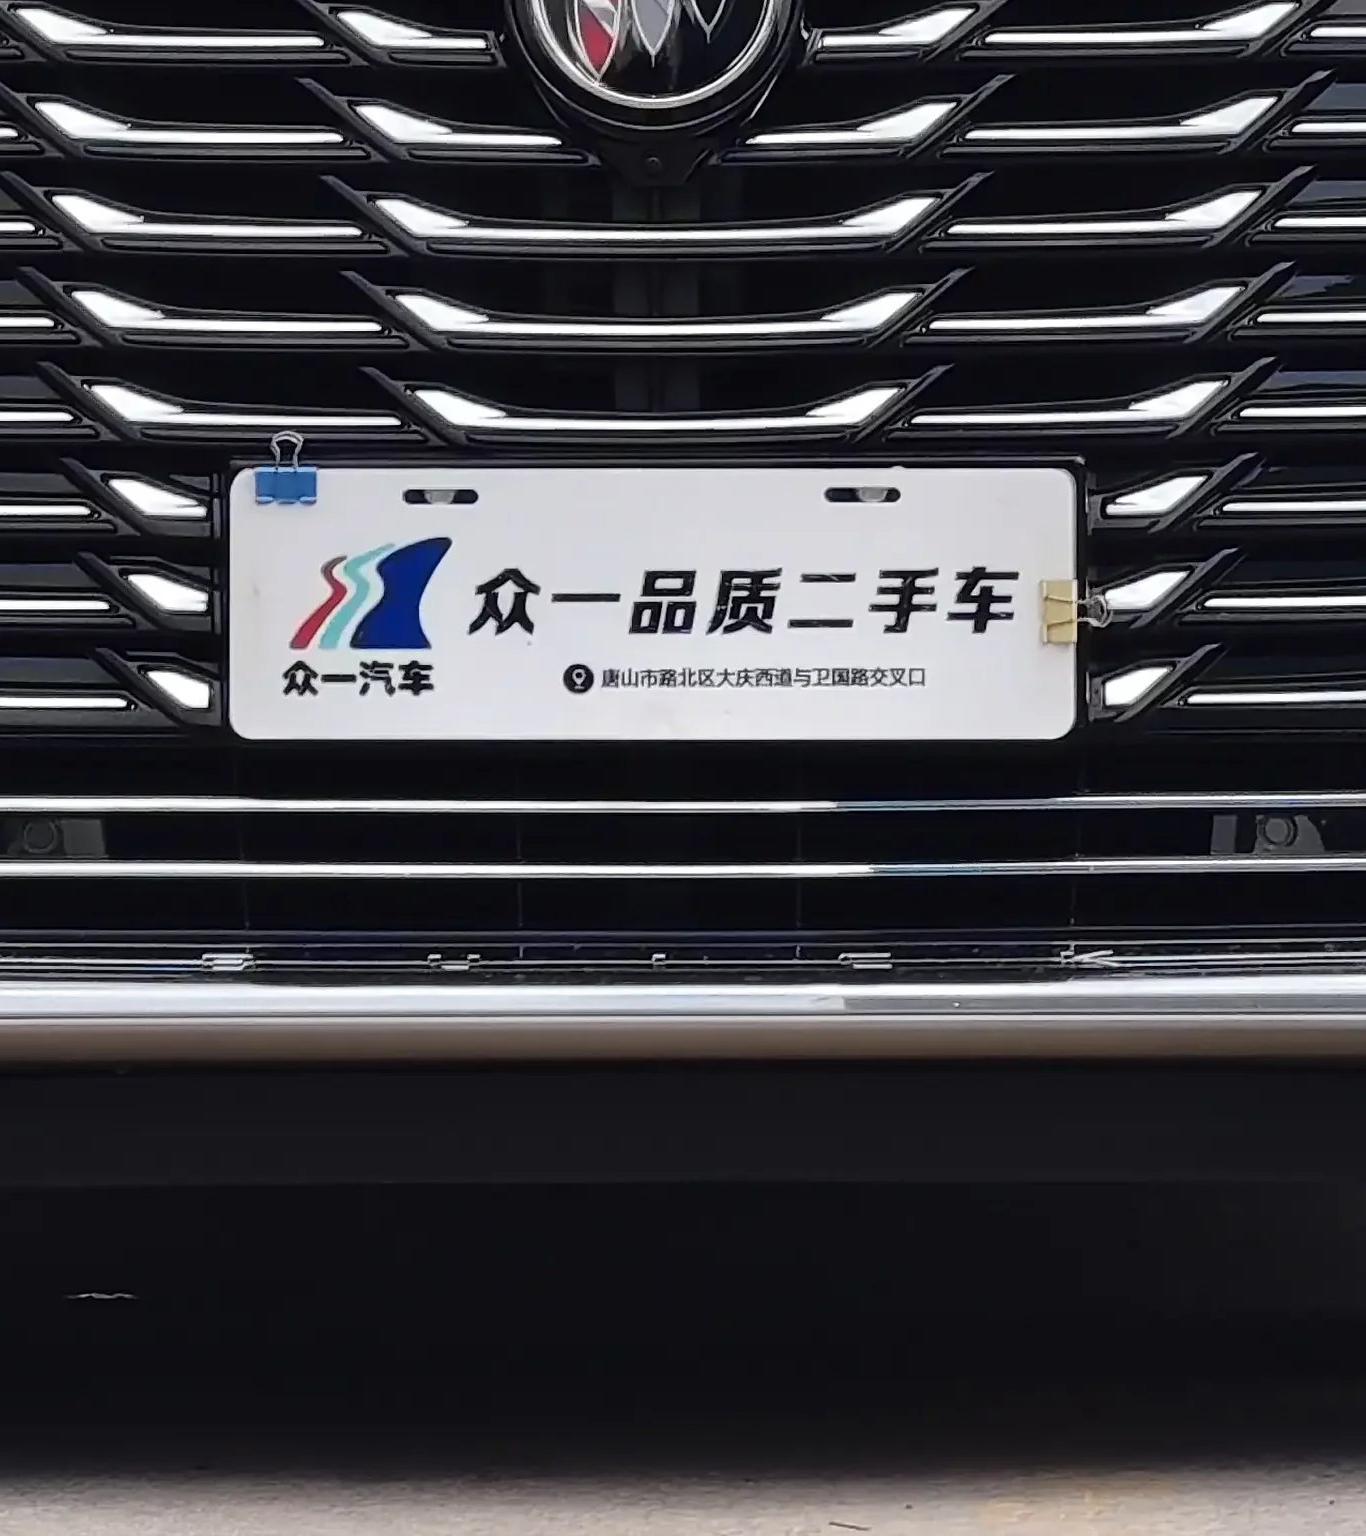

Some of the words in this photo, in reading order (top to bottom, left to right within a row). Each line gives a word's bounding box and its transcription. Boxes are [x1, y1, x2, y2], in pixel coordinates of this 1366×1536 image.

[467, 566, 1020, 636] 众一品质二手车
[282, 659, 434, 697] 众一汽车
[601, 667, 925, 688] 唐山市路北区大庆西道与卫国路交叉口
